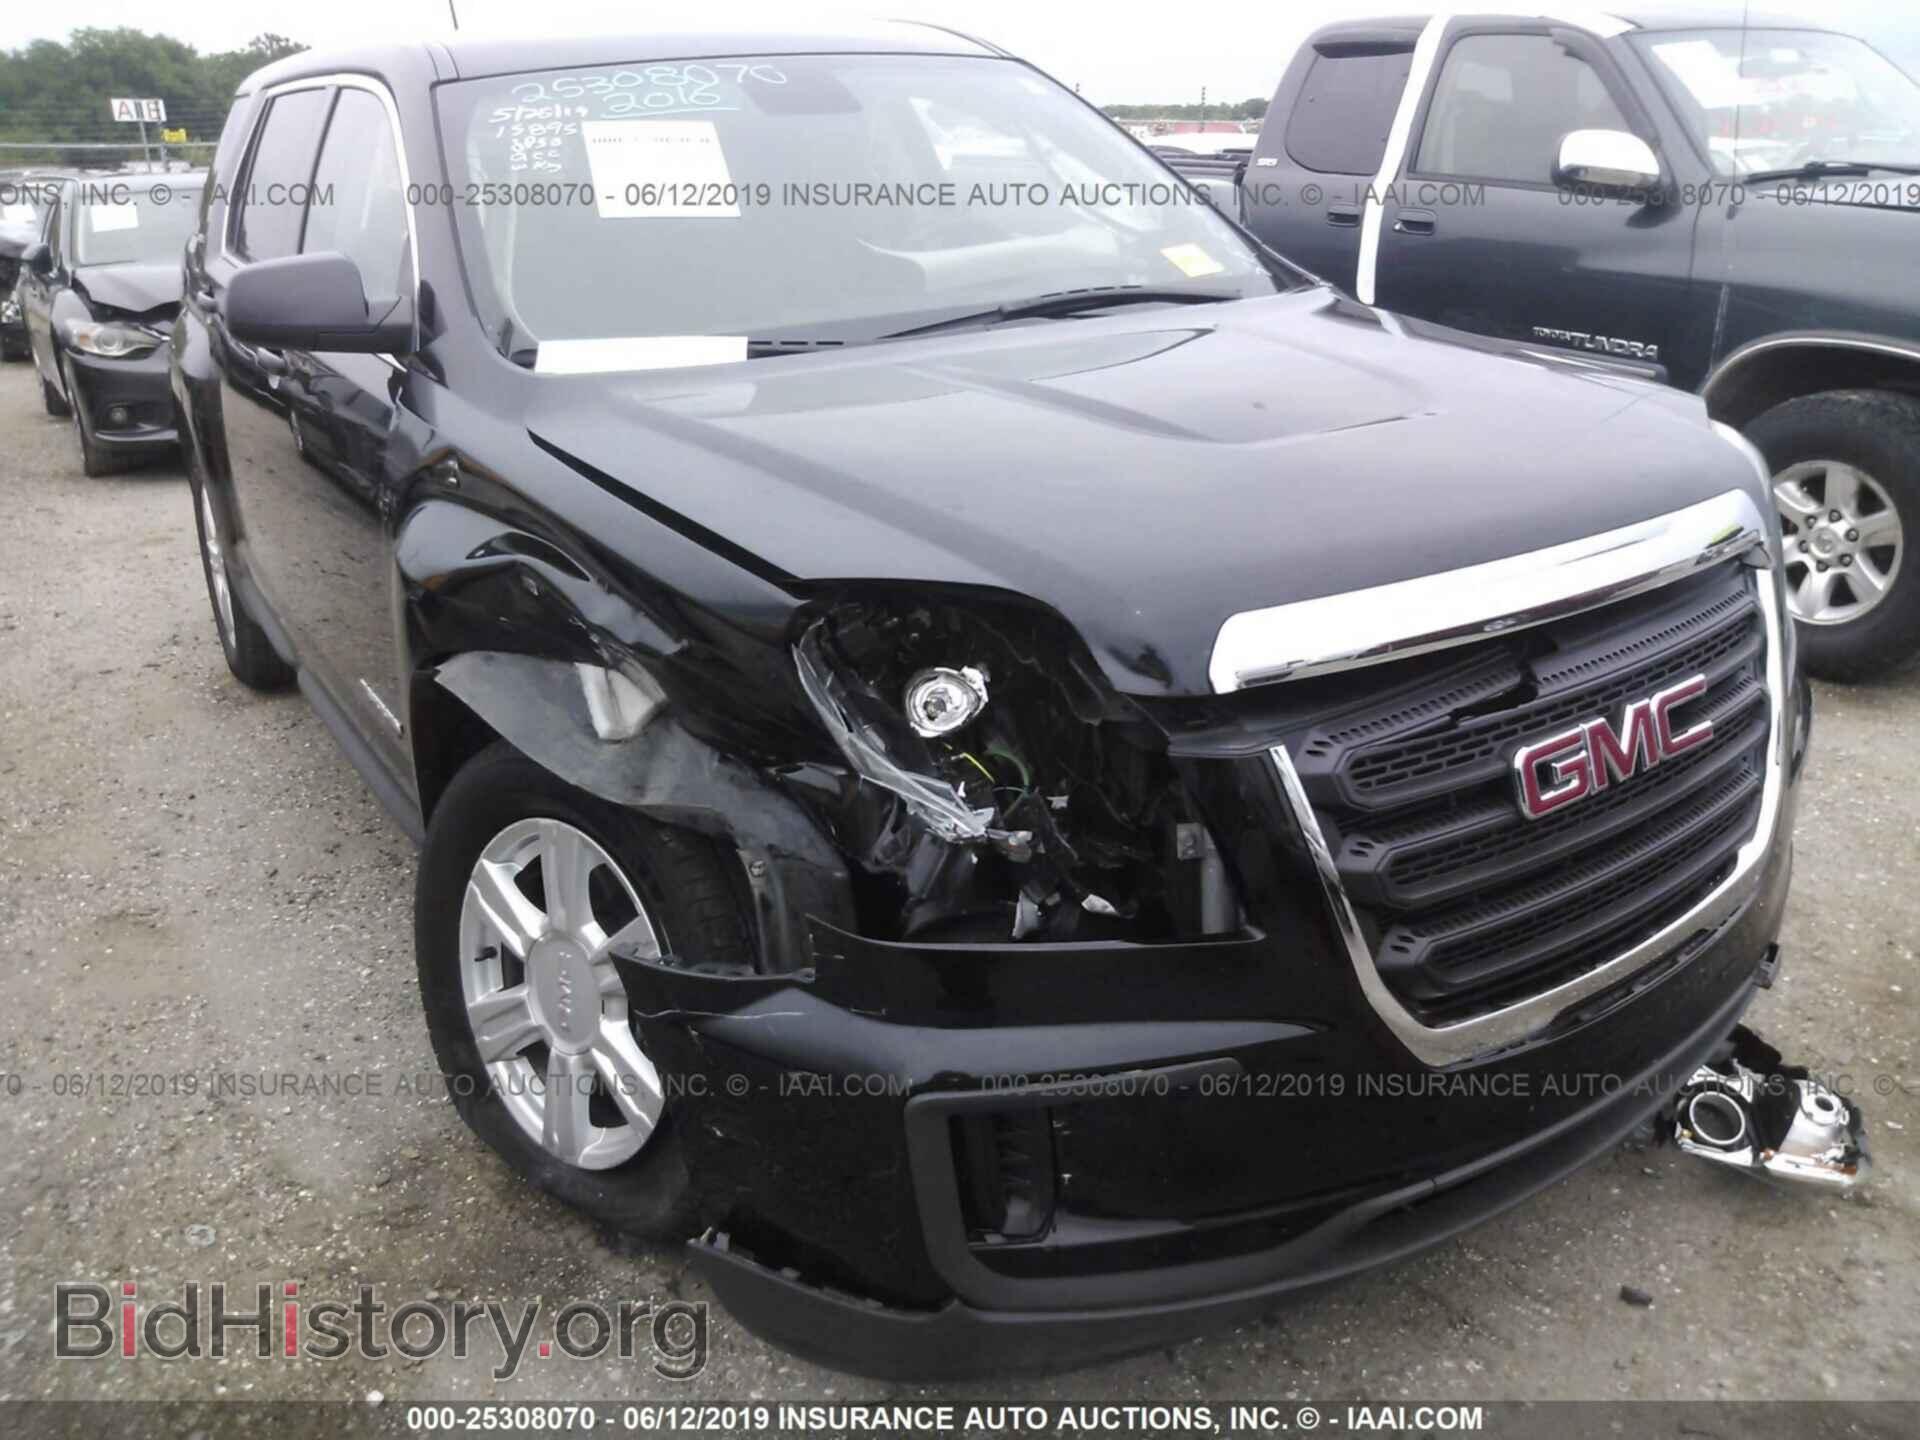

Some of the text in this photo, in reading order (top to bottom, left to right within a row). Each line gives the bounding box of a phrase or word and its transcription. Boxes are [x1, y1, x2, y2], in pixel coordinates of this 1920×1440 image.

[511, 64, 787, 103] 25308070
[602, 86, 721, 112] 2016
[1571, 332, 1658, 360] TUNDRA
[1514, 673, 1714, 820] GMC
